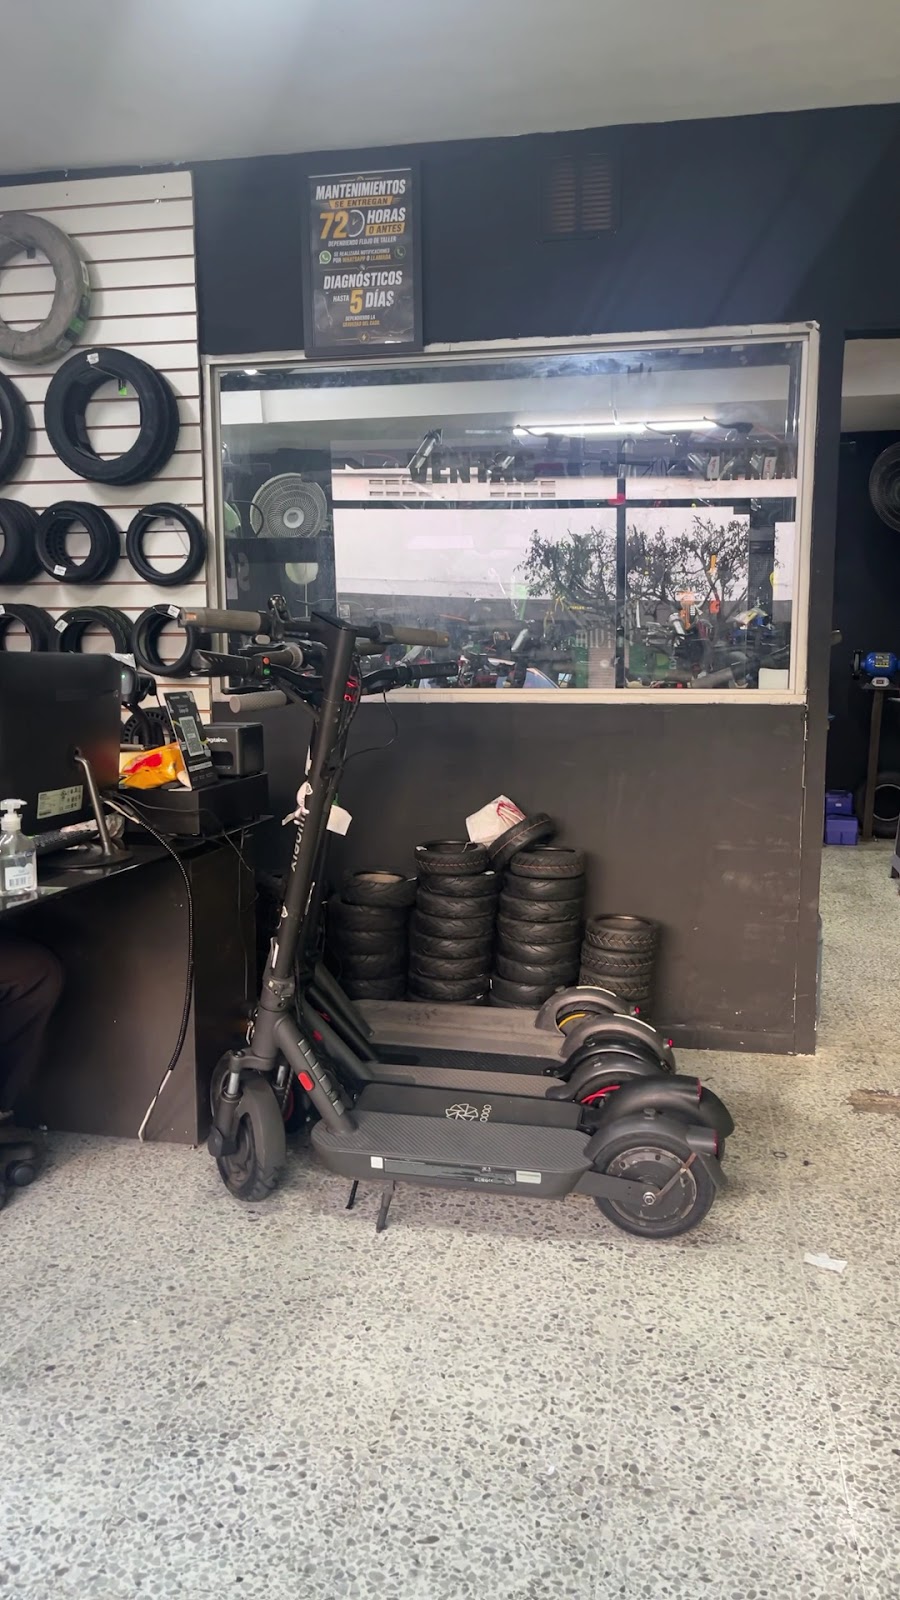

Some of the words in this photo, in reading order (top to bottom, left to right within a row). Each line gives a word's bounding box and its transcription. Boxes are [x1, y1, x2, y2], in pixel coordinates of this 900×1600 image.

[315, 179, 406, 201] MANTENIMIENTOS
[334, 200, 345, 208] SE
[347, 197, 388, 207] ENTREGAN
[320, 210, 349, 240] 72
[366, 207, 406, 224] HORAS
[368, 225, 375, 235] O
[376, 224, 402, 234] ANTES
[328, 239, 358, 248] DEPENDIENDO
[373, 237, 381, 245] DE
[380, 235, 397, 243] TALLER
[323, 270, 403, 290] DIAGNÓSTICOS
[332, 294, 350, 303] HASTA
[349, 288, 364, 315] 5
[365, 288, 395, 308] DÍAS
